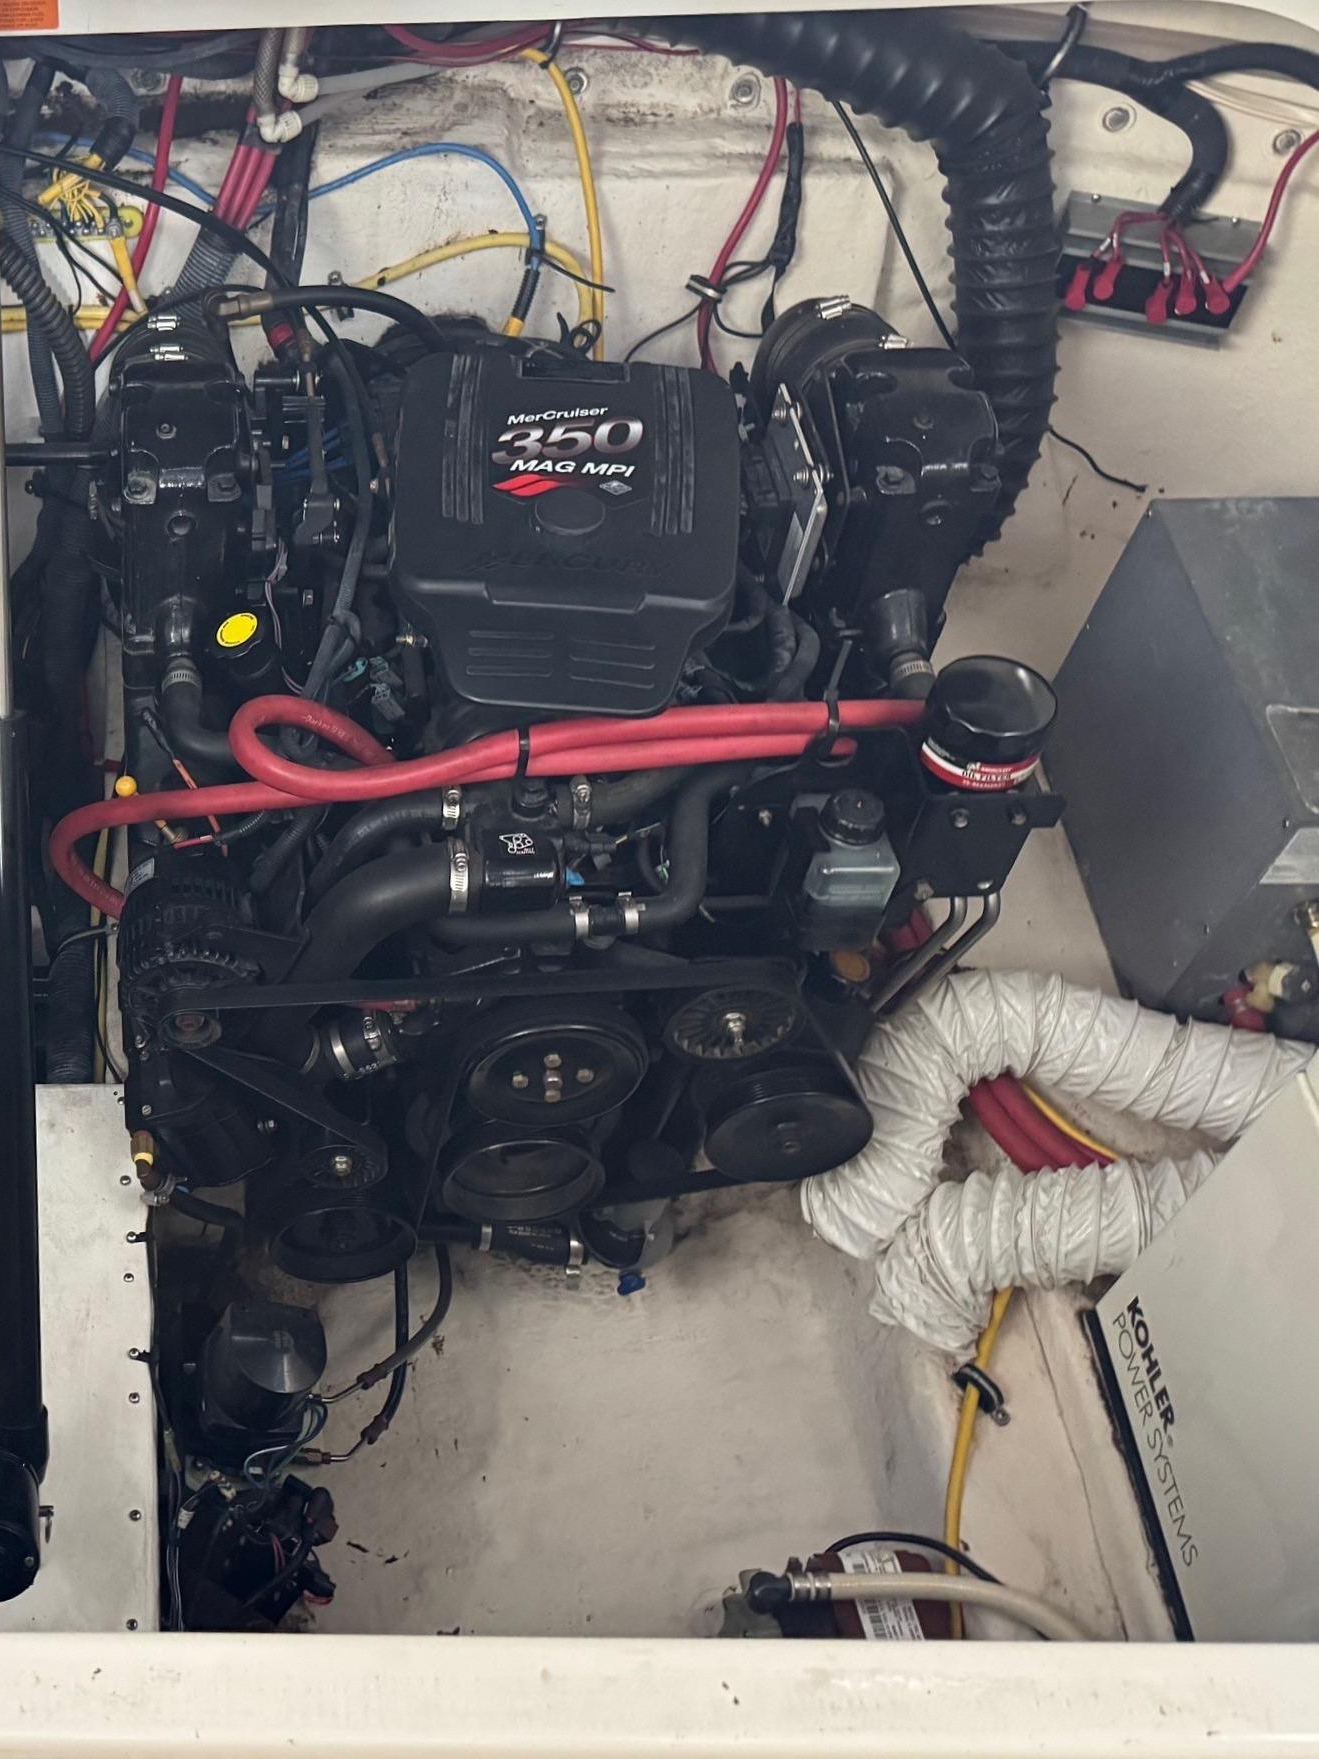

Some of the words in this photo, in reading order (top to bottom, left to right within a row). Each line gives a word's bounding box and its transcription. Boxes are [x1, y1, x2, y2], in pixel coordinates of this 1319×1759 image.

[507, 407, 609, 425] MerCruiser
[491, 417, 644, 465] 350
[510, 459, 577, 473] MAG
[580, 462, 635, 477] MPI
[1127, 1296, 1175, 1435] KOHLER
[1112, 1311, 1153, 1427] POWER
[1146, 1427, 1199, 1567] SYSTEMS
